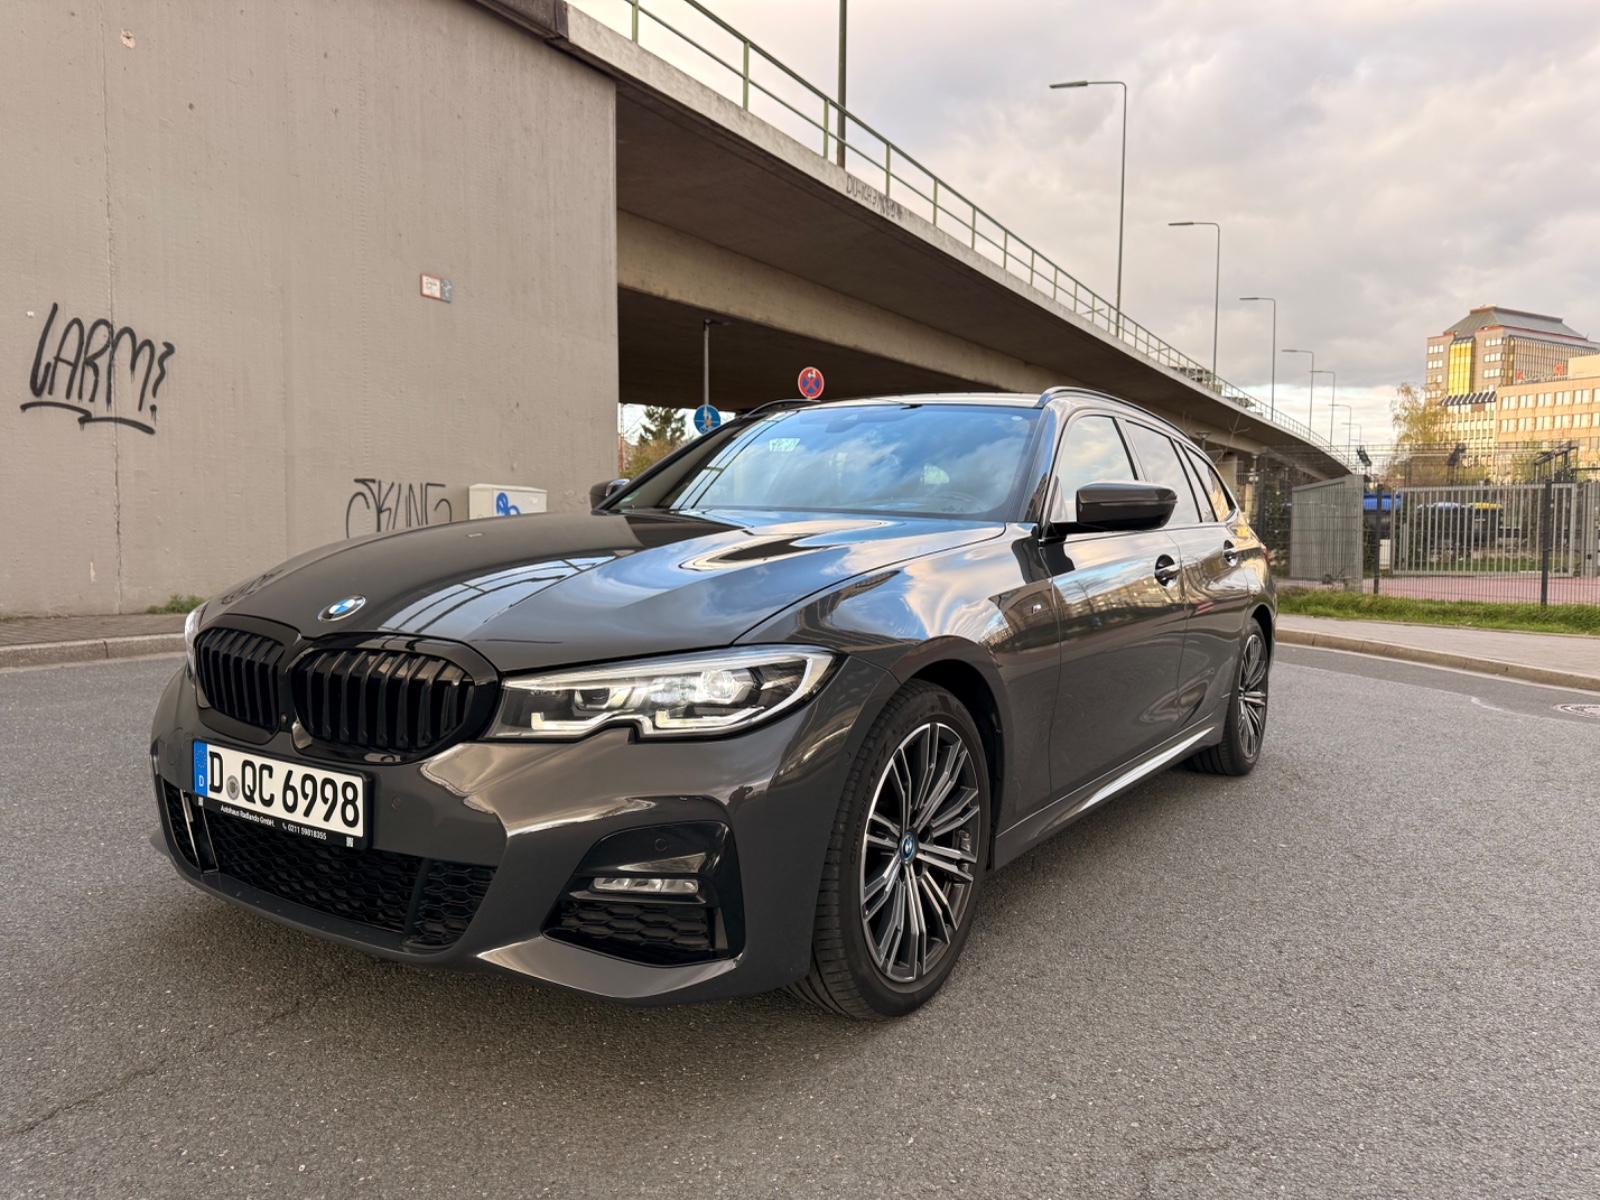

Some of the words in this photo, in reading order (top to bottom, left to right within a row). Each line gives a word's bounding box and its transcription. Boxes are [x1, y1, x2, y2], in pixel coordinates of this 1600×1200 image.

[209, 751, 223, 794] D
[241, 759, 275, 808] QC
[282, 769, 360, 828] 6998
